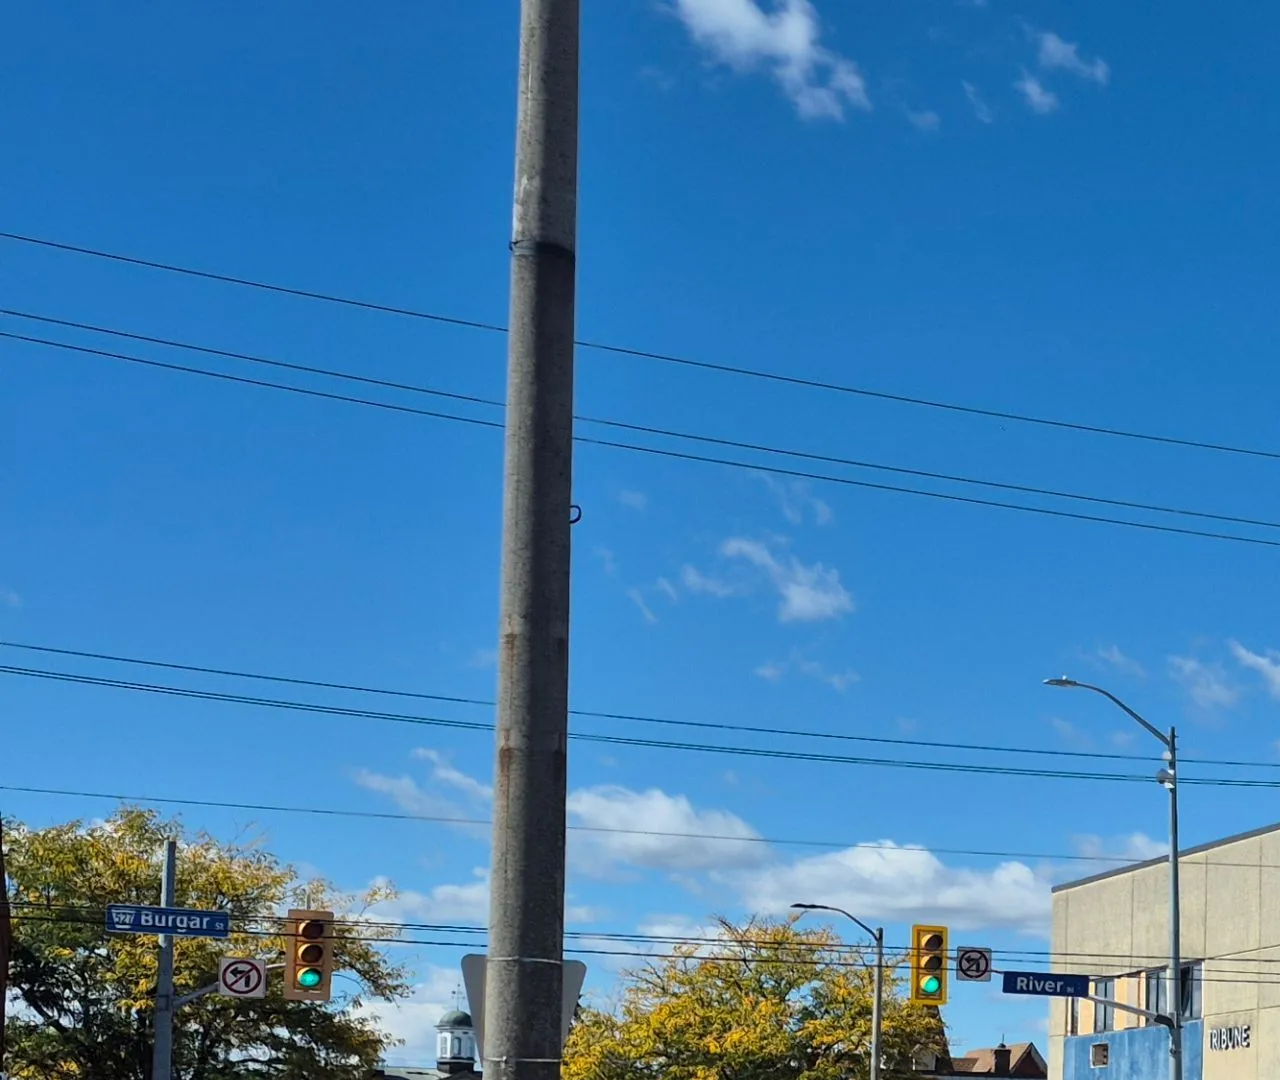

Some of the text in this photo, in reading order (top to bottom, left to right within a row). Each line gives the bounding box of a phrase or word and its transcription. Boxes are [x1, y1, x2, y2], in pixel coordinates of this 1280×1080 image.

[140, 911, 210, 933] Burgar
[1016, 976, 1064, 993] River
[1208, 1025, 1251, 1050] TRIBUNE
